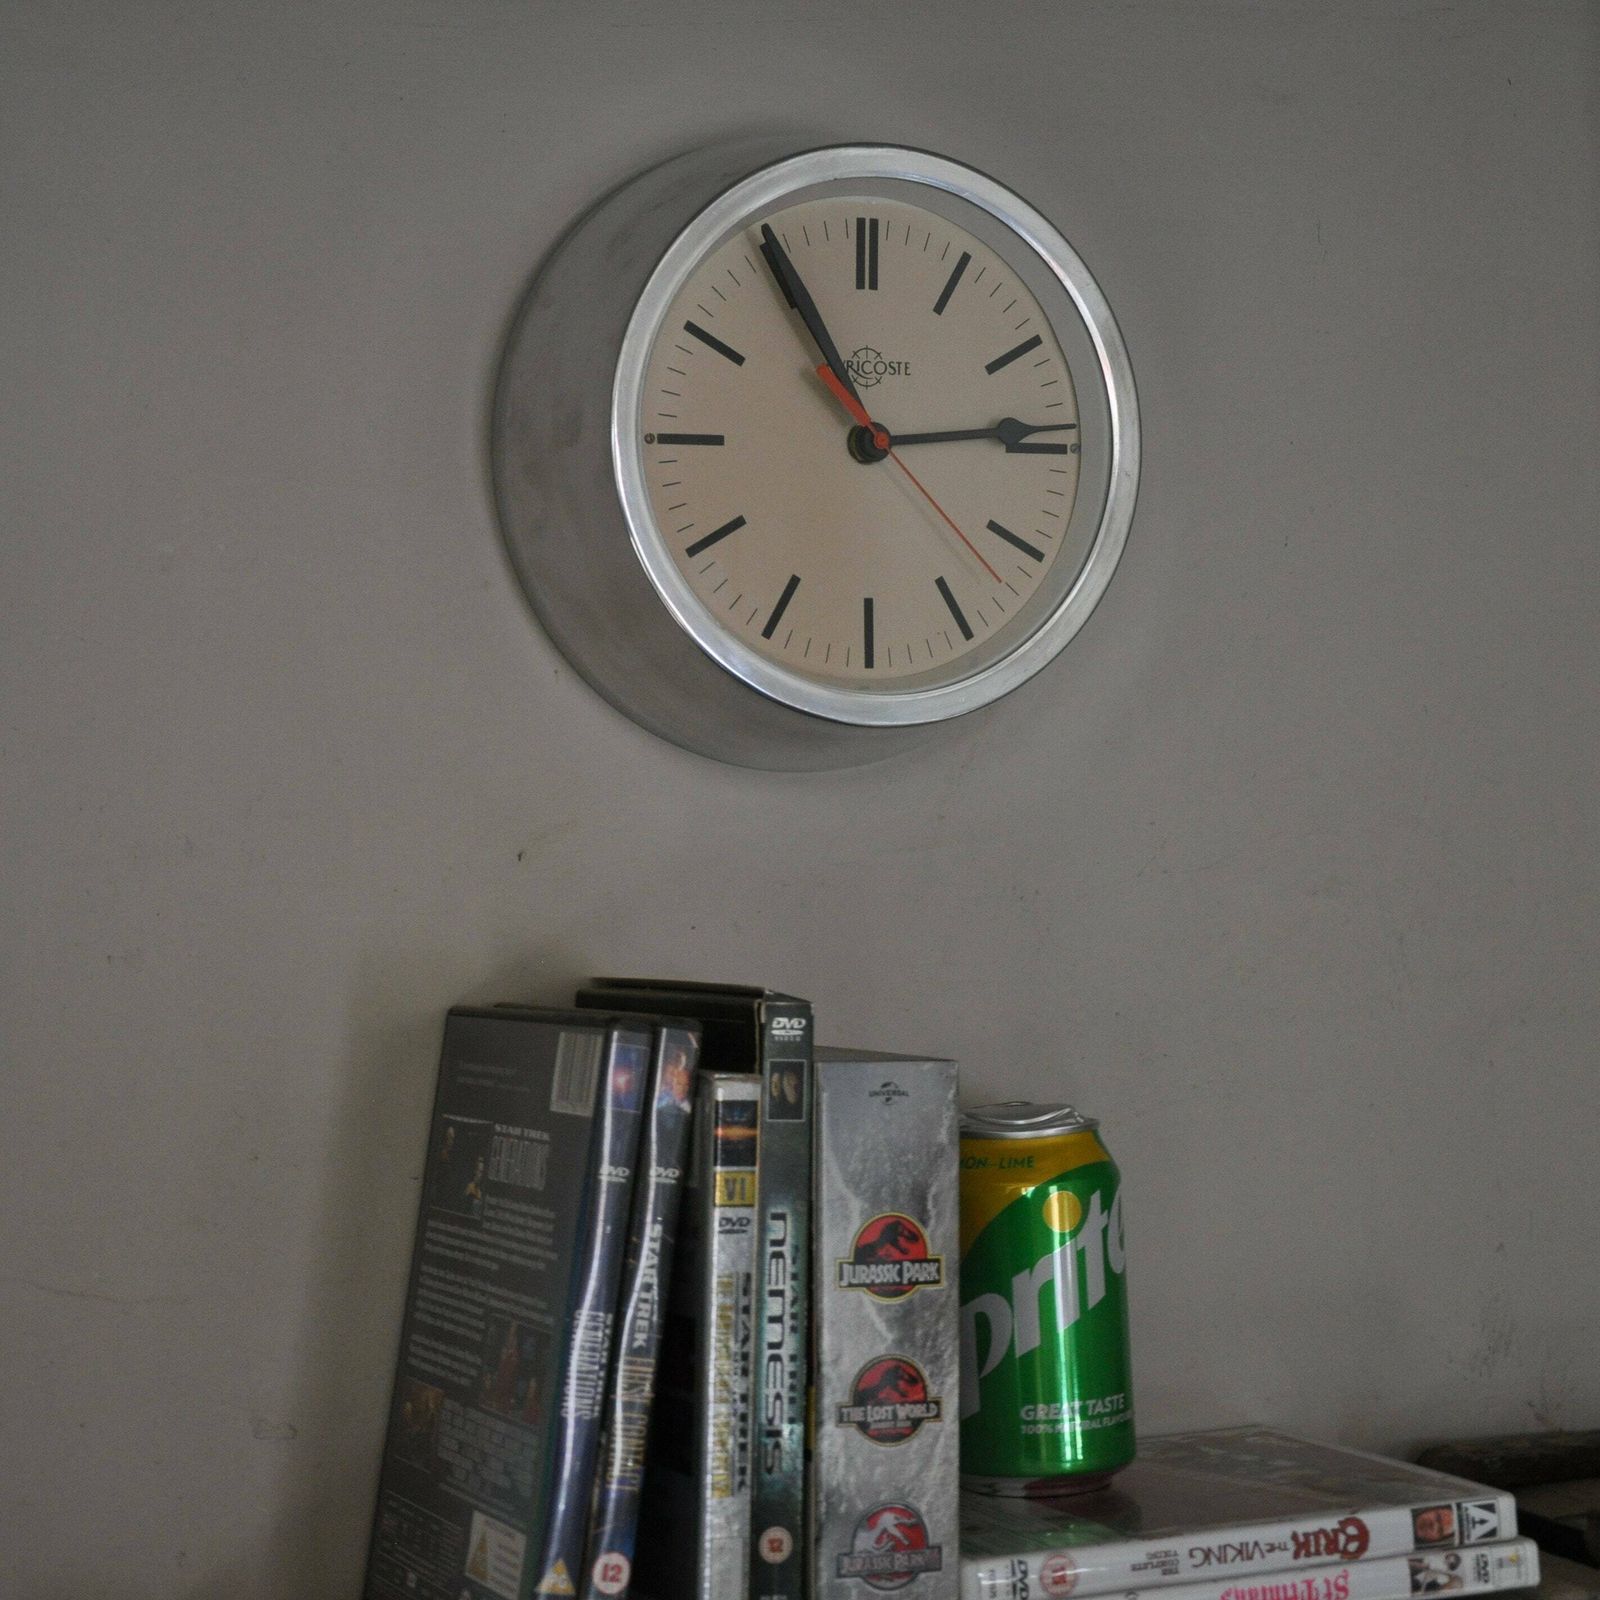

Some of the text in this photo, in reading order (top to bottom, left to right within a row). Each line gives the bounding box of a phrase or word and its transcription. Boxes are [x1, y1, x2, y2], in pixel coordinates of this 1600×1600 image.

[842, 360, 912, 380] RICOSTE
[771, 1017, 807, 1029] DVD
[868, 1089, 910, 1098] UNIVERSAL
[999, 1155, 1035, 1169] LIME
[724, 1177, 746, 1201] VI
[718, 1216, 751, 1227] DVD
[839, 1260, 941, 1286] JURASSIC PARK
[632, 1222, 663, 1349] STAR TREK
[789, 1244, 800, 1334] STAR
[560, 1309, 606, 1420] GENERATIONS
[739, 1272, 751, 1492] STAR TREK
[840, 1402, 938, 1422] THE LOST WORLD
[1020, 1393, 1125, 1421] GREAT TASTE
[1188, 1516, 1370, 1568] ERIK THE VIKING
[602, 1563, 623, 1583] 12
